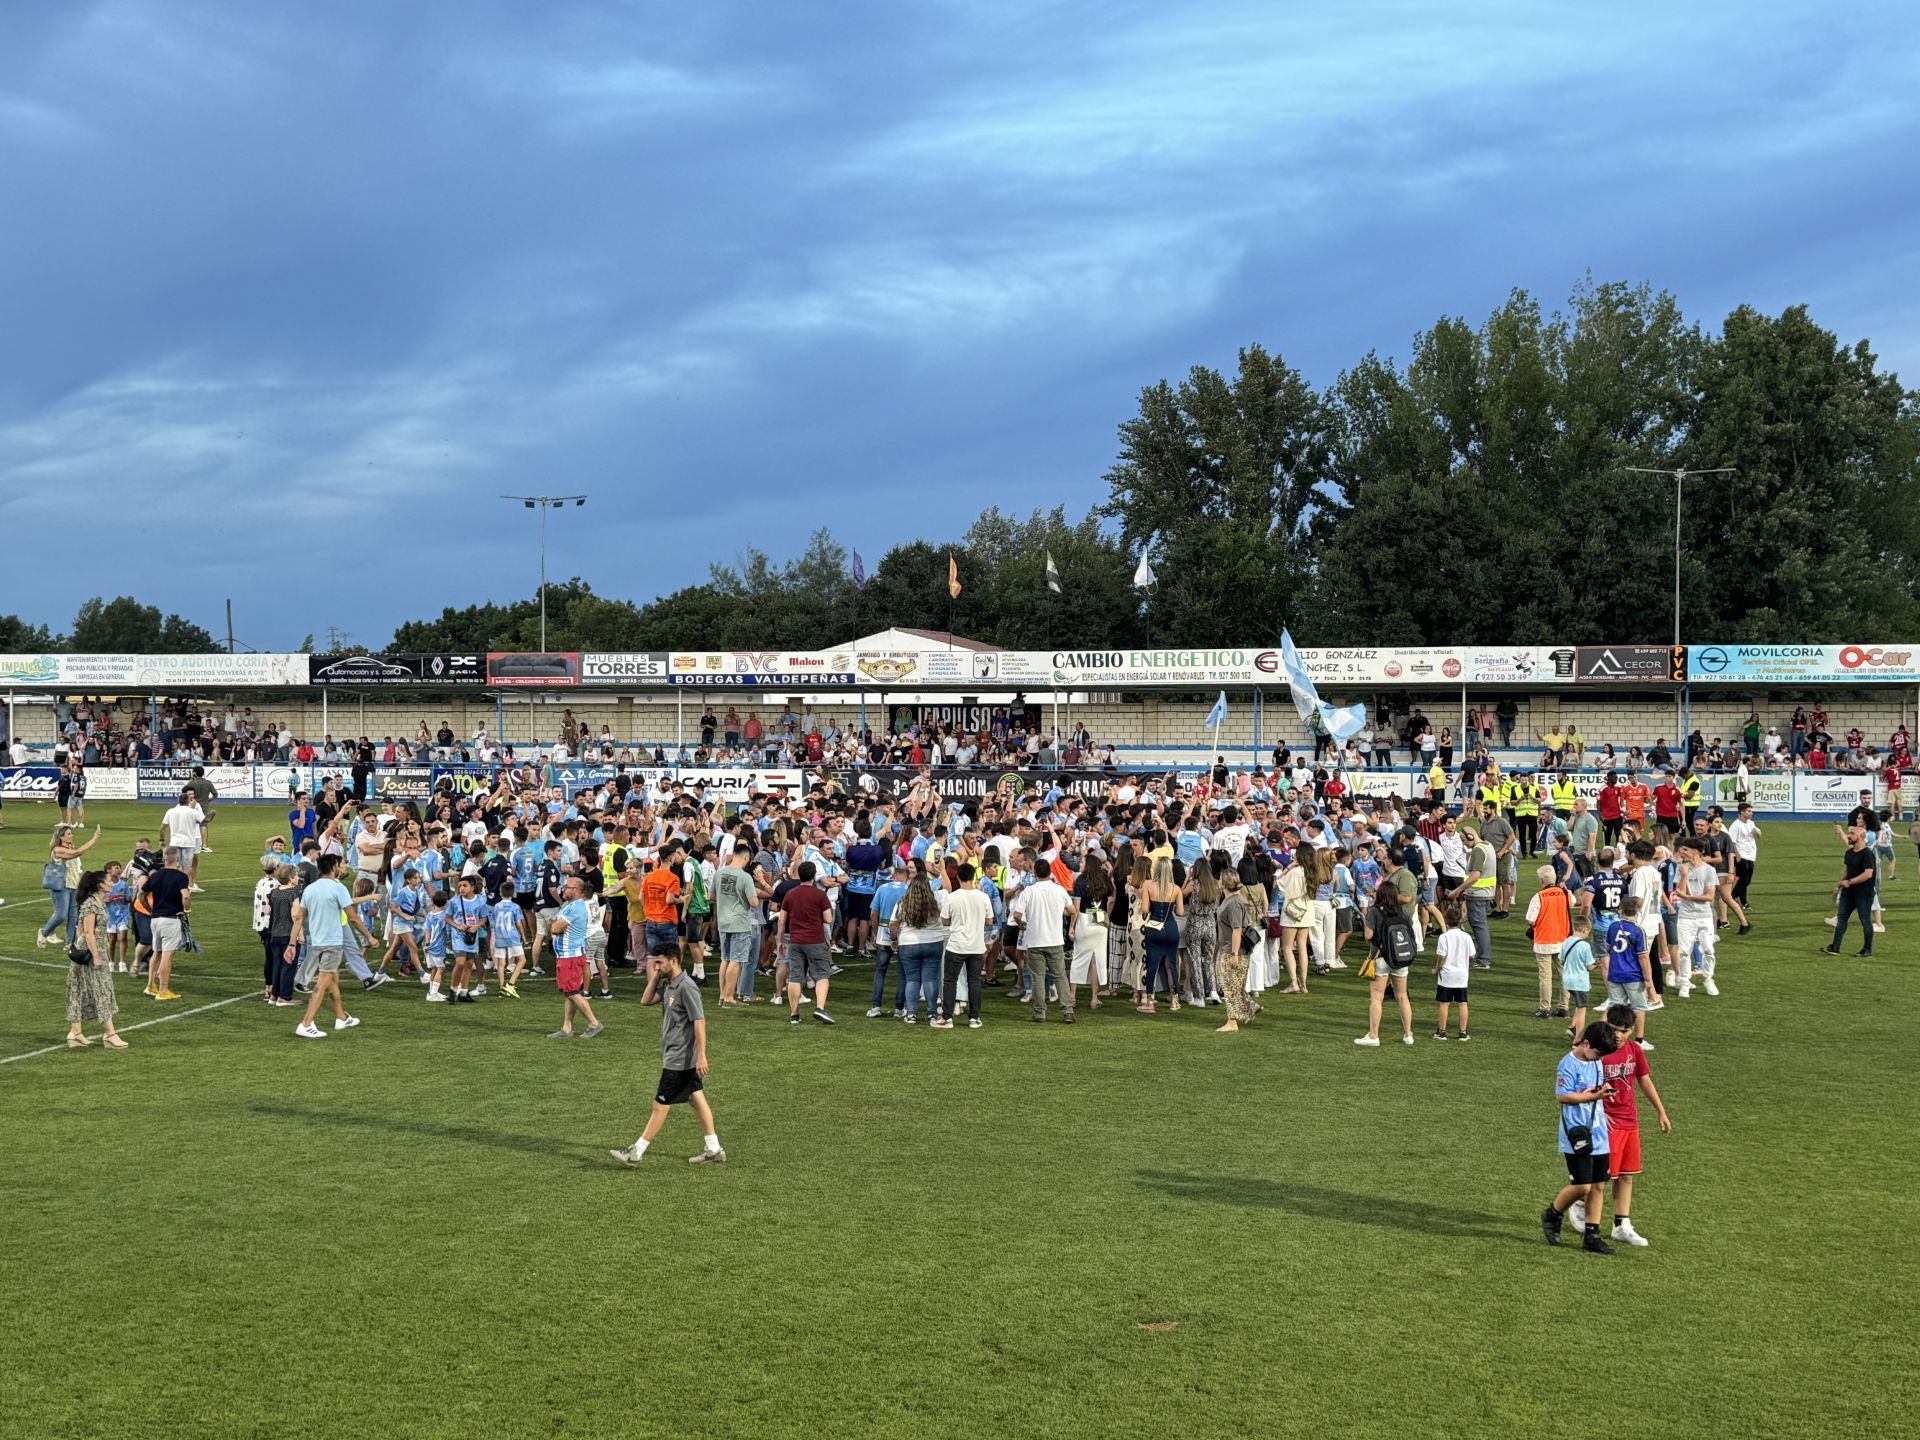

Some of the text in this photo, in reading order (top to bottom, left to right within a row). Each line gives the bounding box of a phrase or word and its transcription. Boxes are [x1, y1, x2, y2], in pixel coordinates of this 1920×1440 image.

[1326, 649, 1378, 660] GONZÁLEZ
[1738, 648, 1824, 657] MOVILCORIA
[137, 657, 268, 668] CENTRO AUDITIVO CORIA
[735, 653, 778, 673] BVC
[789, 657, 825, 666] Mahou
[1053, 651, 1245, 668] CAMBIO ENERGETICO
[586, 663, 658, 675] TORRES
[1304, 662, 1342, 673] NCHEZ,
[675, 674, 848, 684] BODEGAS VALDEPEÑAS
[1082, 672, 1118, 681] ESPECIALISTAS
[1118, 672, 1126, 680] EN
[1150, 671, 1167, 680] SOLAR
[1894, 734, 1905, 745] 28
[140, 769, 163, 778] DUCHA
[89, 776, 130, 786] Vaquero
[1754, 781, 1791, 791] Prado
[1754, 791, 1790, 801] Plantel
[524, 857, 532, 873] 5
[1603, 886, 1622, 908] 16
[1612, 929, 1631, 953] 5
